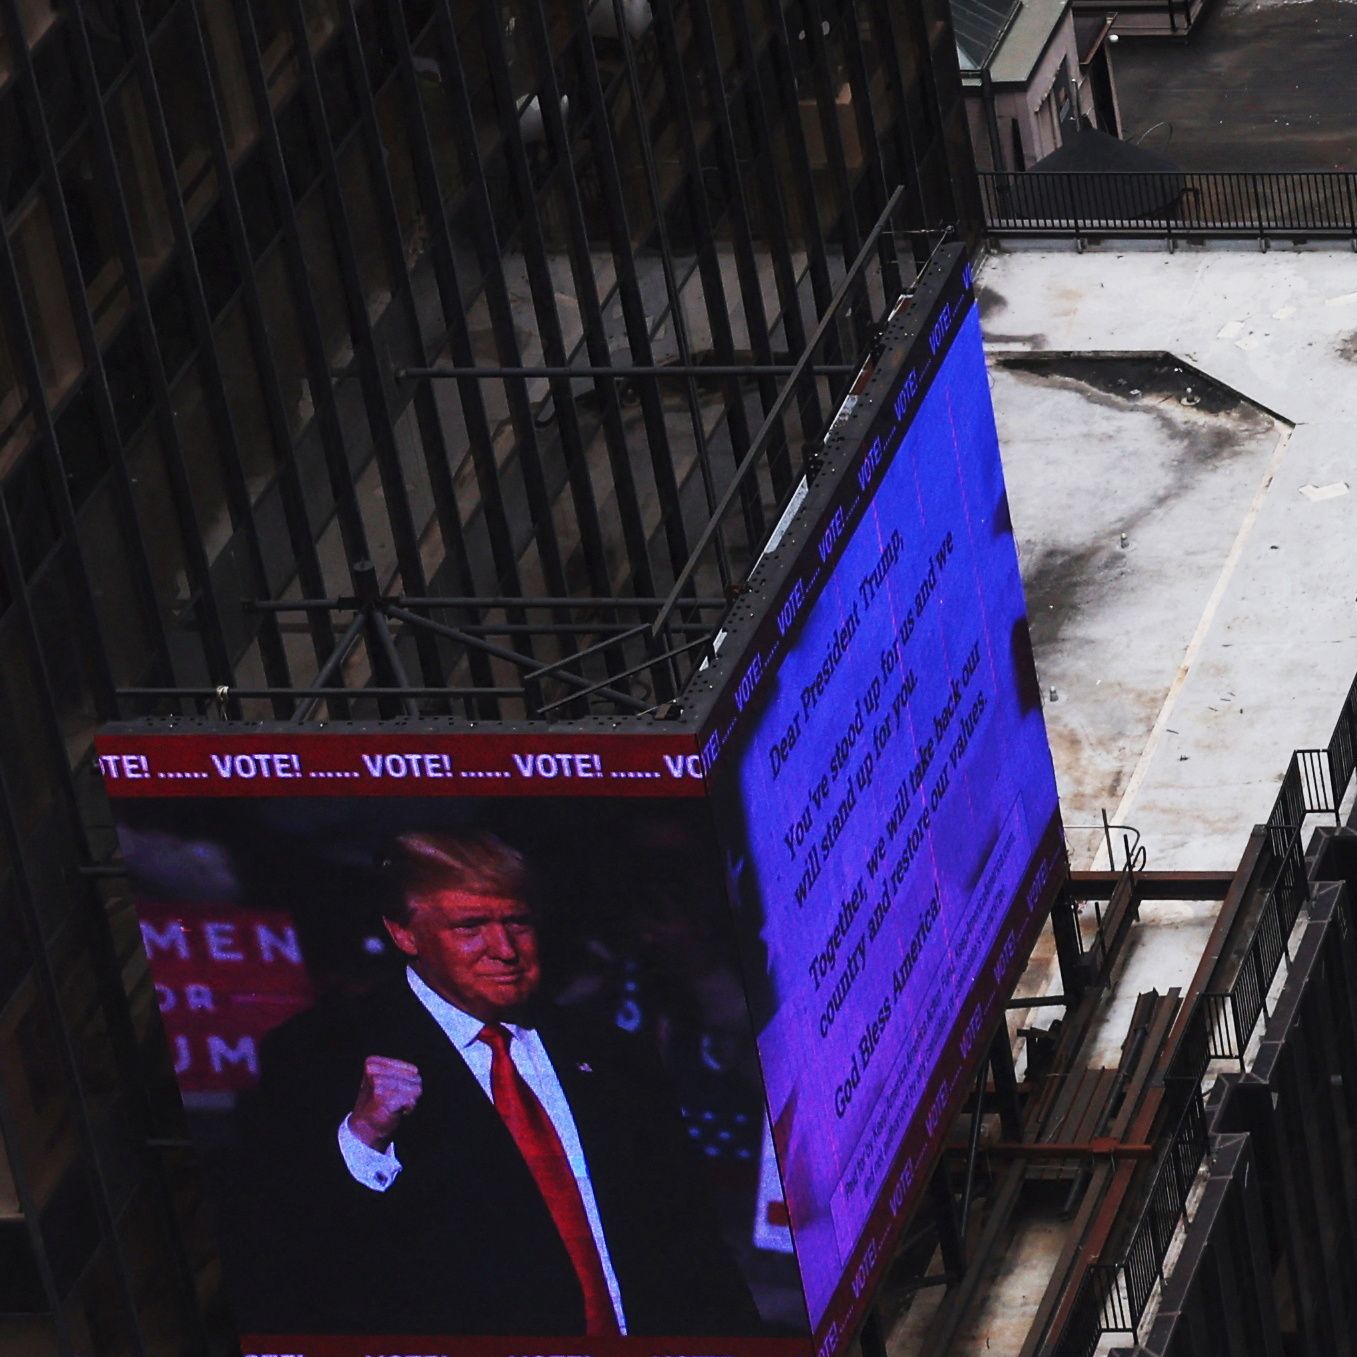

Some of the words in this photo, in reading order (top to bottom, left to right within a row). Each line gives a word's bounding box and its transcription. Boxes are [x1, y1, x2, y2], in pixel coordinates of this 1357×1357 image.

[735, 652, 763, 713] VOTE!
[777, 577, 805, 637] VOTE!
[818, 504, 846, 563] VOTE!
[858, 435, 882, 492] VOTE!
[894, 367, 919, 421] VOTE!
[929, 302, 951, 355] VOTE!
[98, 754, 151, 778] TE!
[211, 753, 301, 779] VOTE!
[362, 753, 452, 779] VOTE!
[513, 753, 603, 779] VOTE!
[769, 712, 800, 779] Dear
[800, 602, 859, 721] President
[858, 529, 903, 609] Trump,
[784, 774, 829, 860] You've
[829, 700, 863, 781] stood
[863, 676, 880, 715] up
[880, 637, 899, 684] for
[899, 608, 914, 645] us
[914, 556, 936, 617] and
[935, 531, 953, 570] we
[794, 844, 821, 907] will
[820, 776, 856, 860] stand
[855, 751, 873, 791] up
[872, 713, 891, 760] for
[892, 669, 917, 729] you.
[808, 879, 867, 989] Together,
[866, 836, 886, 878] we
[886, 780, 910, 840] will
[909, 738, 934, 794] take
[933, 680, 961, 743] back
[961, 641, 980, 687] our
[819, 933, 865, 1037] country
[867, 879, 891, 942] and
[890, 807, 930, 894] restore
[930, 763, 949, 812] our
[949, 691, 987, 768] values.
[834, 1054, 860, 1118] God
[858, 997, 891, 1069] Bless
[892, 884, 940, 1001] America!
